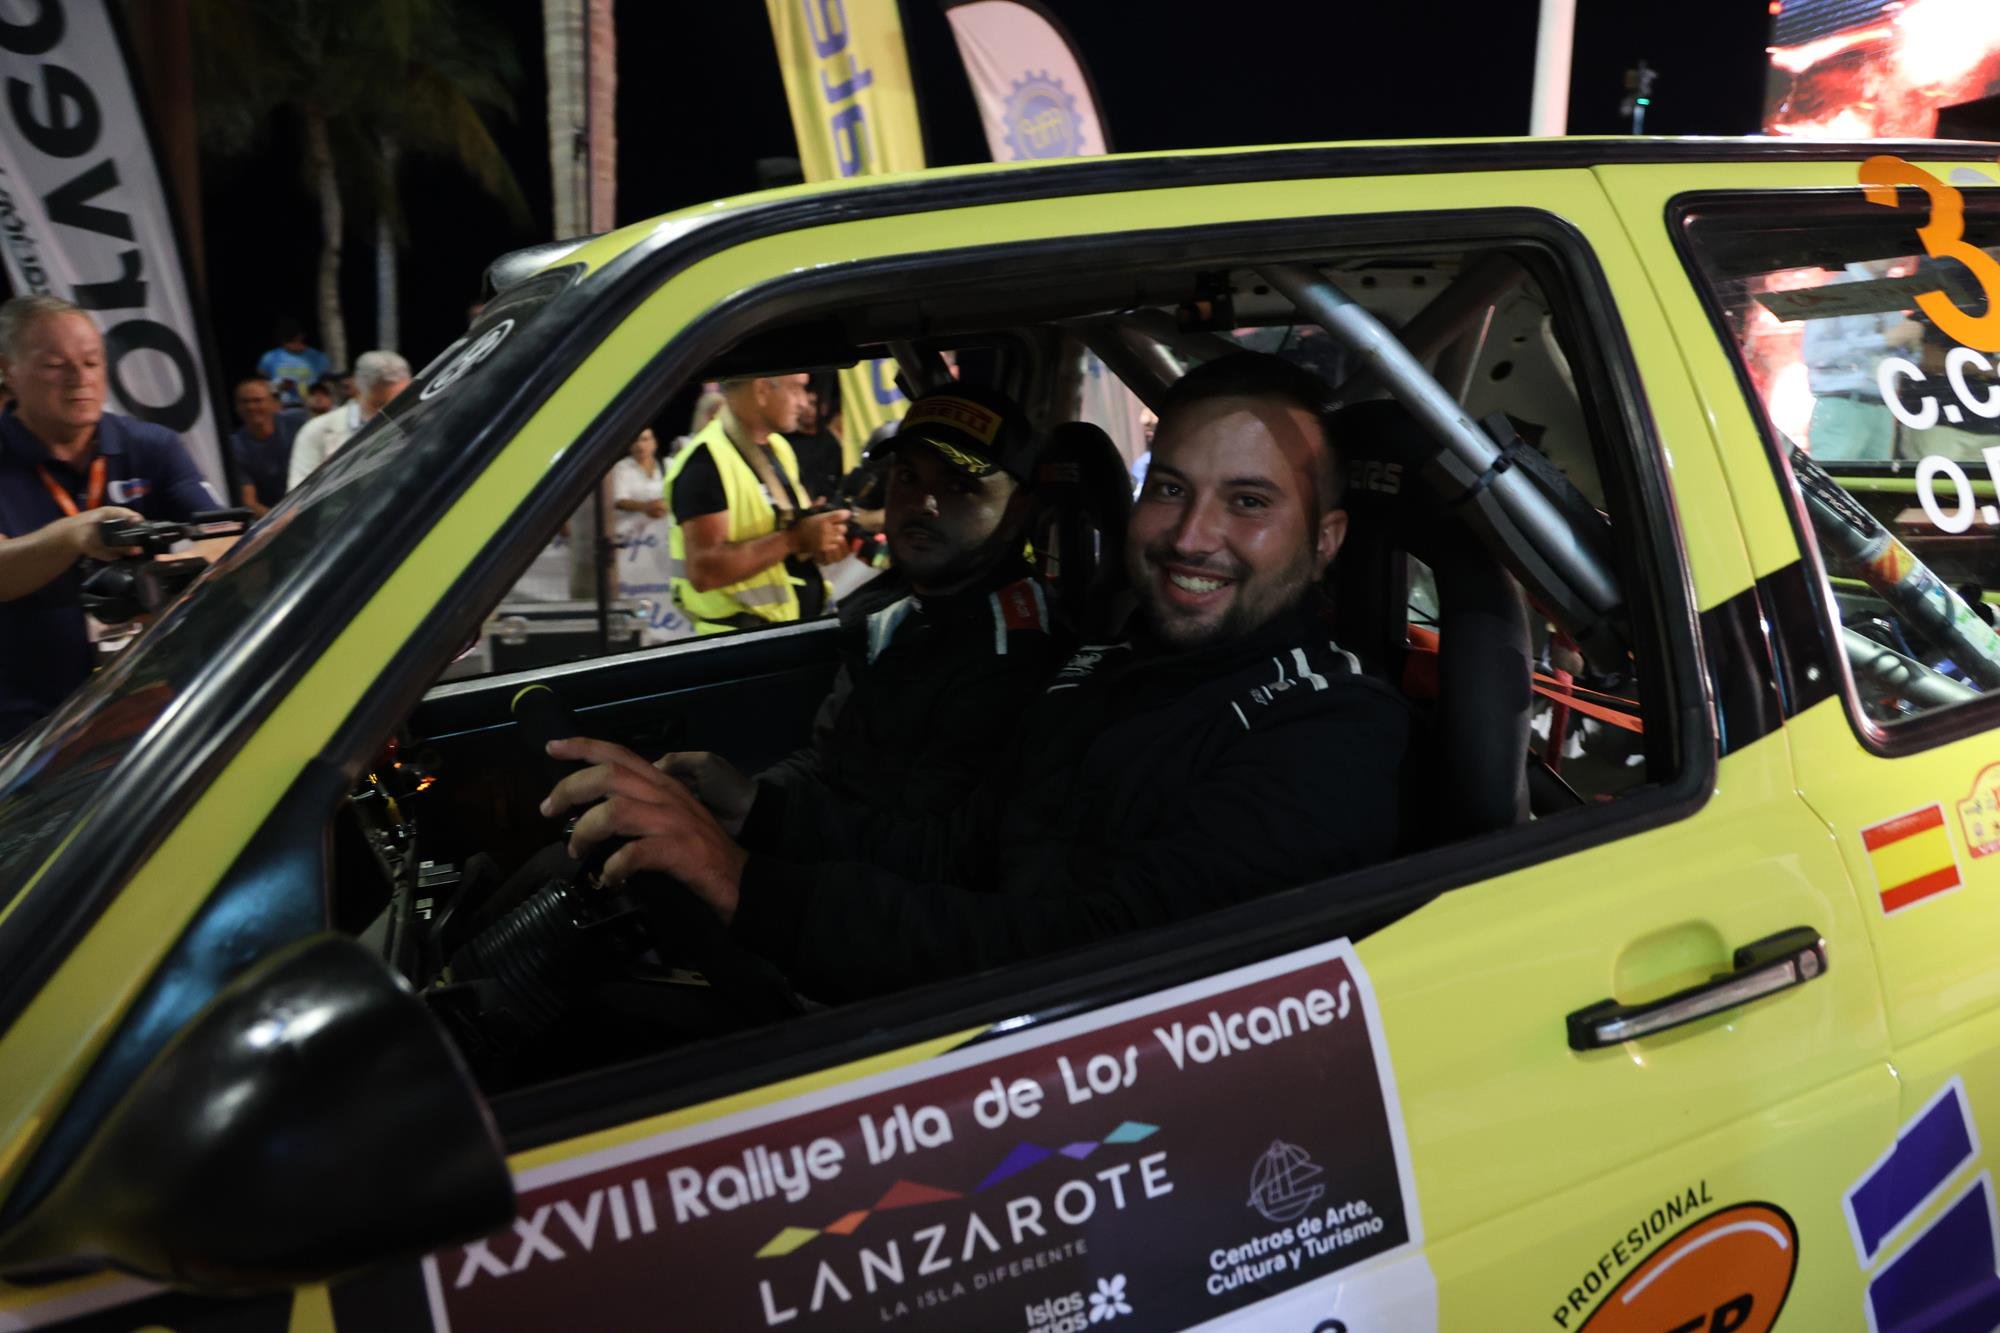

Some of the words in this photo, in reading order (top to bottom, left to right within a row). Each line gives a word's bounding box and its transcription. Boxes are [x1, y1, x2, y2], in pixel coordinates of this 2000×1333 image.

[1876, 346, 2000, 431] C.C
[453, 1177, 658, 1290] XXVII
[667, 1136, 845, 1225] Rallye
[858, 1101, 955, 1166] Isla
[972, 1076, 1045, 1131] de
[1056, 1045, 1139, 1106] Los
[1152, 978, 1353, 1071] Volcanes
[758, 1150, 1175, 1327] LANZAROTE
[1205, 1253, 1287, 1296] Cultura
[1287, 1248, 1302, 1271] y
[1302, 1215, 1385, 1259] Turismo
[1208, 1227, 1296, 1271] Centros
[1295, 1217, 1323, 1240] de
[1325, 1199, 1374, 1230] Arte,
[1552, 1178, 1715, 1330] PROFESIONAL
[880, 1301, 909, 1322] LA
[916, 1281, 967, 1309] ISLA
[972, 1238, 1089, 1291] DIFERENTE
[1024, 1290, 1085, 1328] Islas
